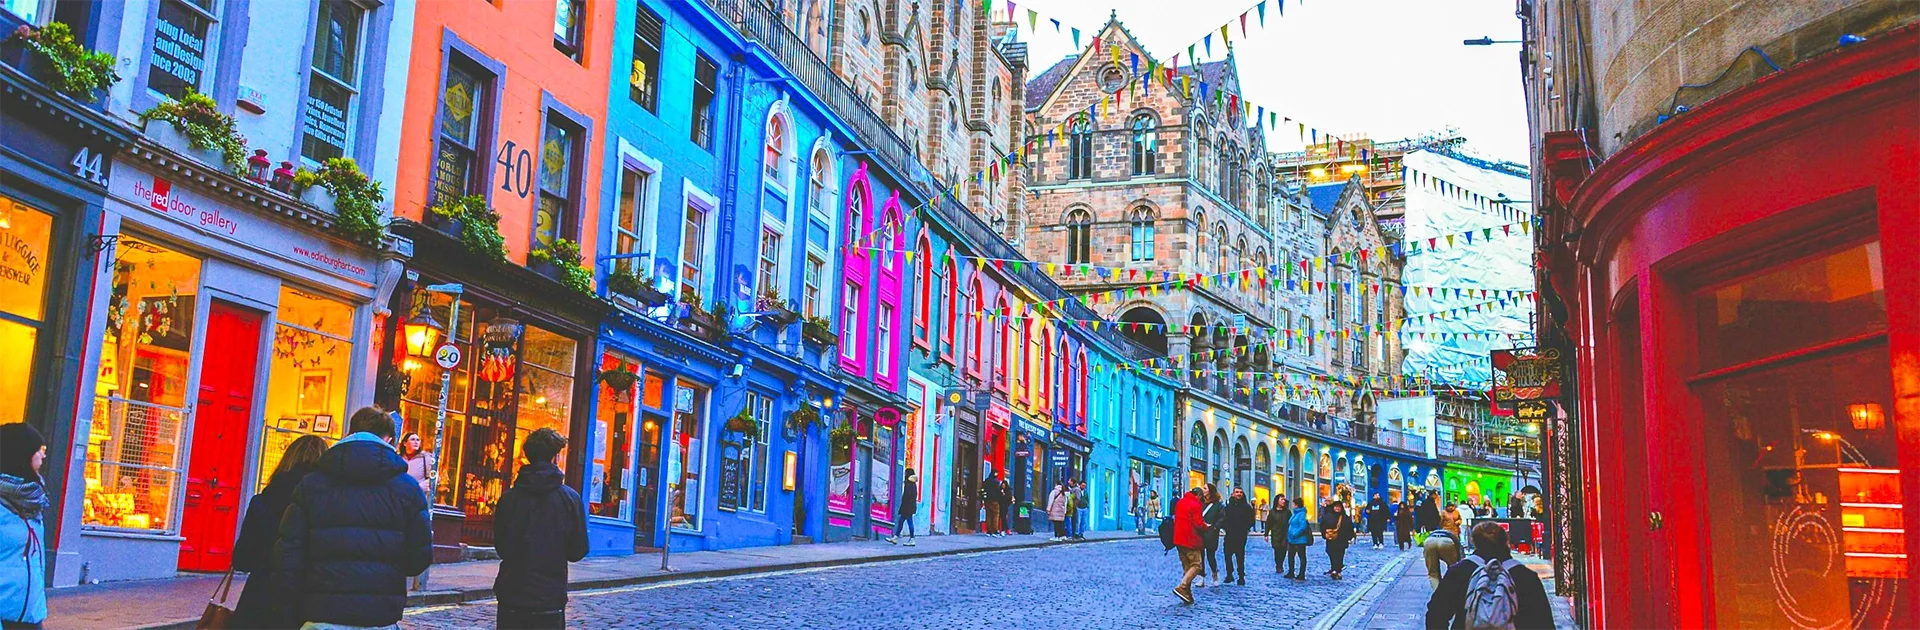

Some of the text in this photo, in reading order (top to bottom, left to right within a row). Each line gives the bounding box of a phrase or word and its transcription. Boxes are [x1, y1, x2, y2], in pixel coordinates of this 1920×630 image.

[156, 36, 204, 72] and Design
[179, 28, 203, 53] Local
[152, 50, 196, 85] ince 2003
[497, 140, 531, 198] 40
[134, 181, 238, 235] the red door gallery
[0, 264, 31, 286] ENSWEAR
[293, 246, 366, 276] www.edinburghart.com
